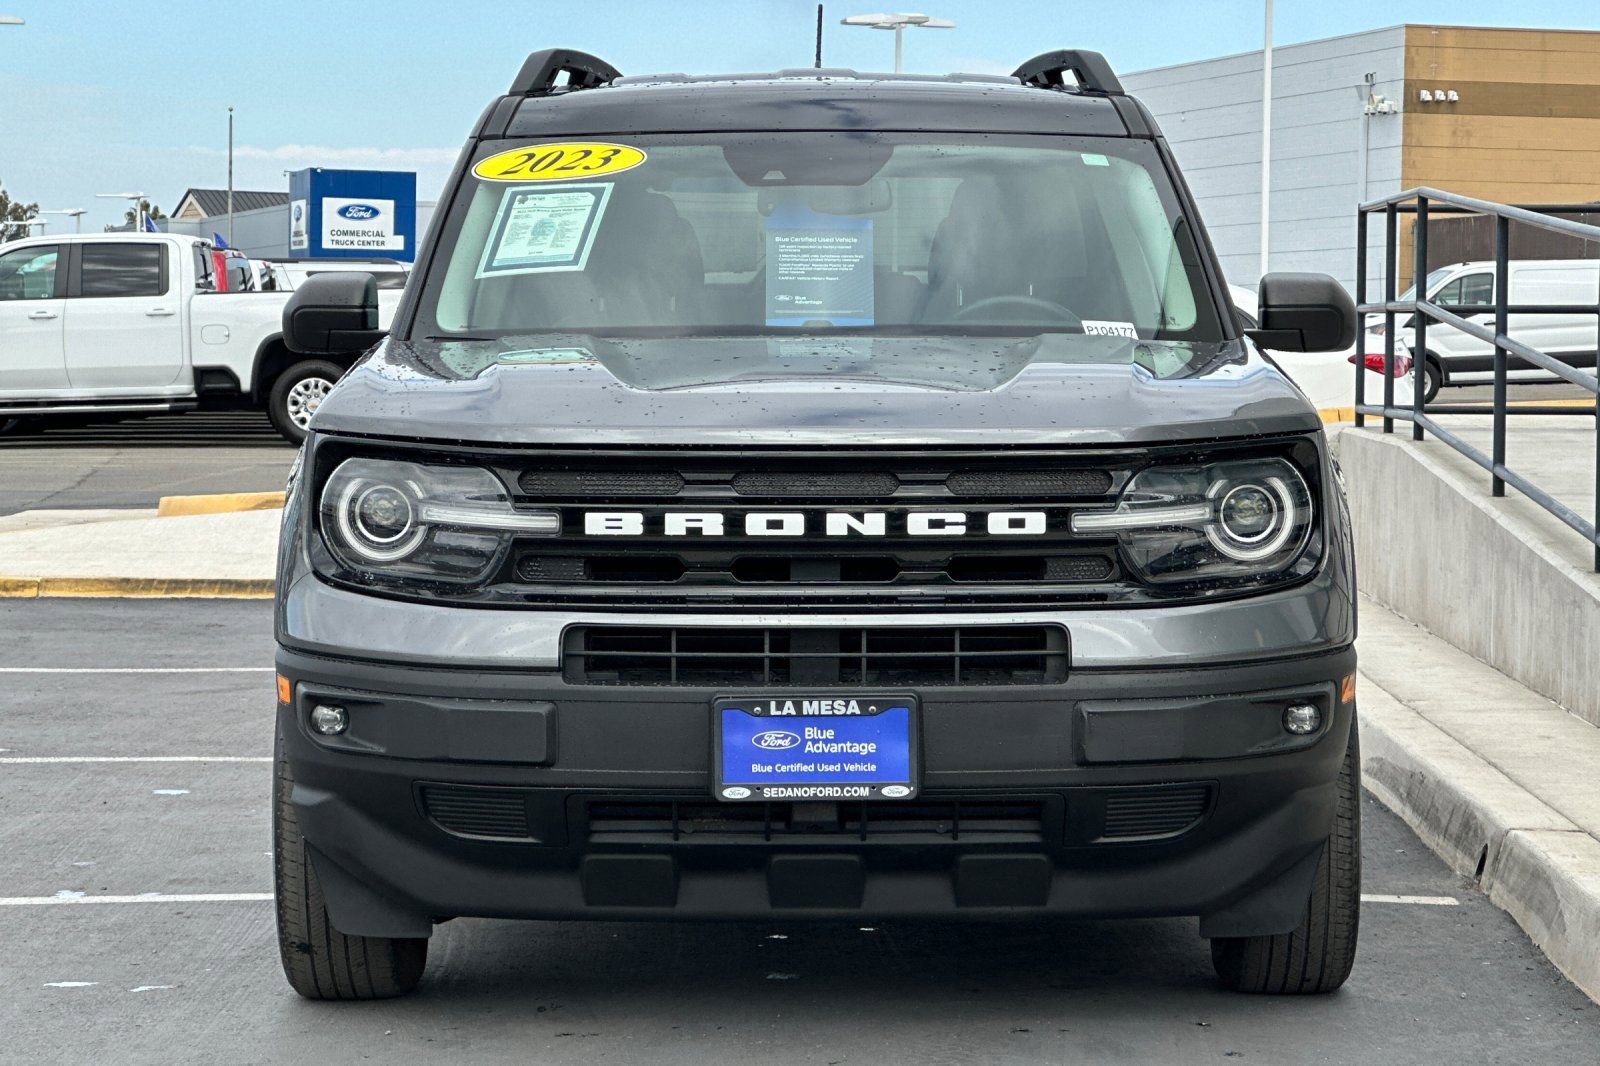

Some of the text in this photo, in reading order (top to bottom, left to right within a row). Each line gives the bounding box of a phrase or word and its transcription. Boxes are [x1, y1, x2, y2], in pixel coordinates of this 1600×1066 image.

[497, 148, 622, 176] 2023
[345, 205, 372, 219] Ford
[330, 229, 386, 238] COMMERCIAL
[331, 239, 386, 247] TRUCK CENTER
[1086, 325, 1134, 337] P104177
[584, 512, 1047, 536] BRONCO
[769, 700, 861, 716] LA MESA
[761, 733, 791, 747] Ford
[804, 727, 835, 740] Blue
[804, 741, 877, 755] Advantage
[751, 762, 877, 773] Blue Certified Used Vehicle
[763, 786, 869, 798] SEDANOFORD.COM
